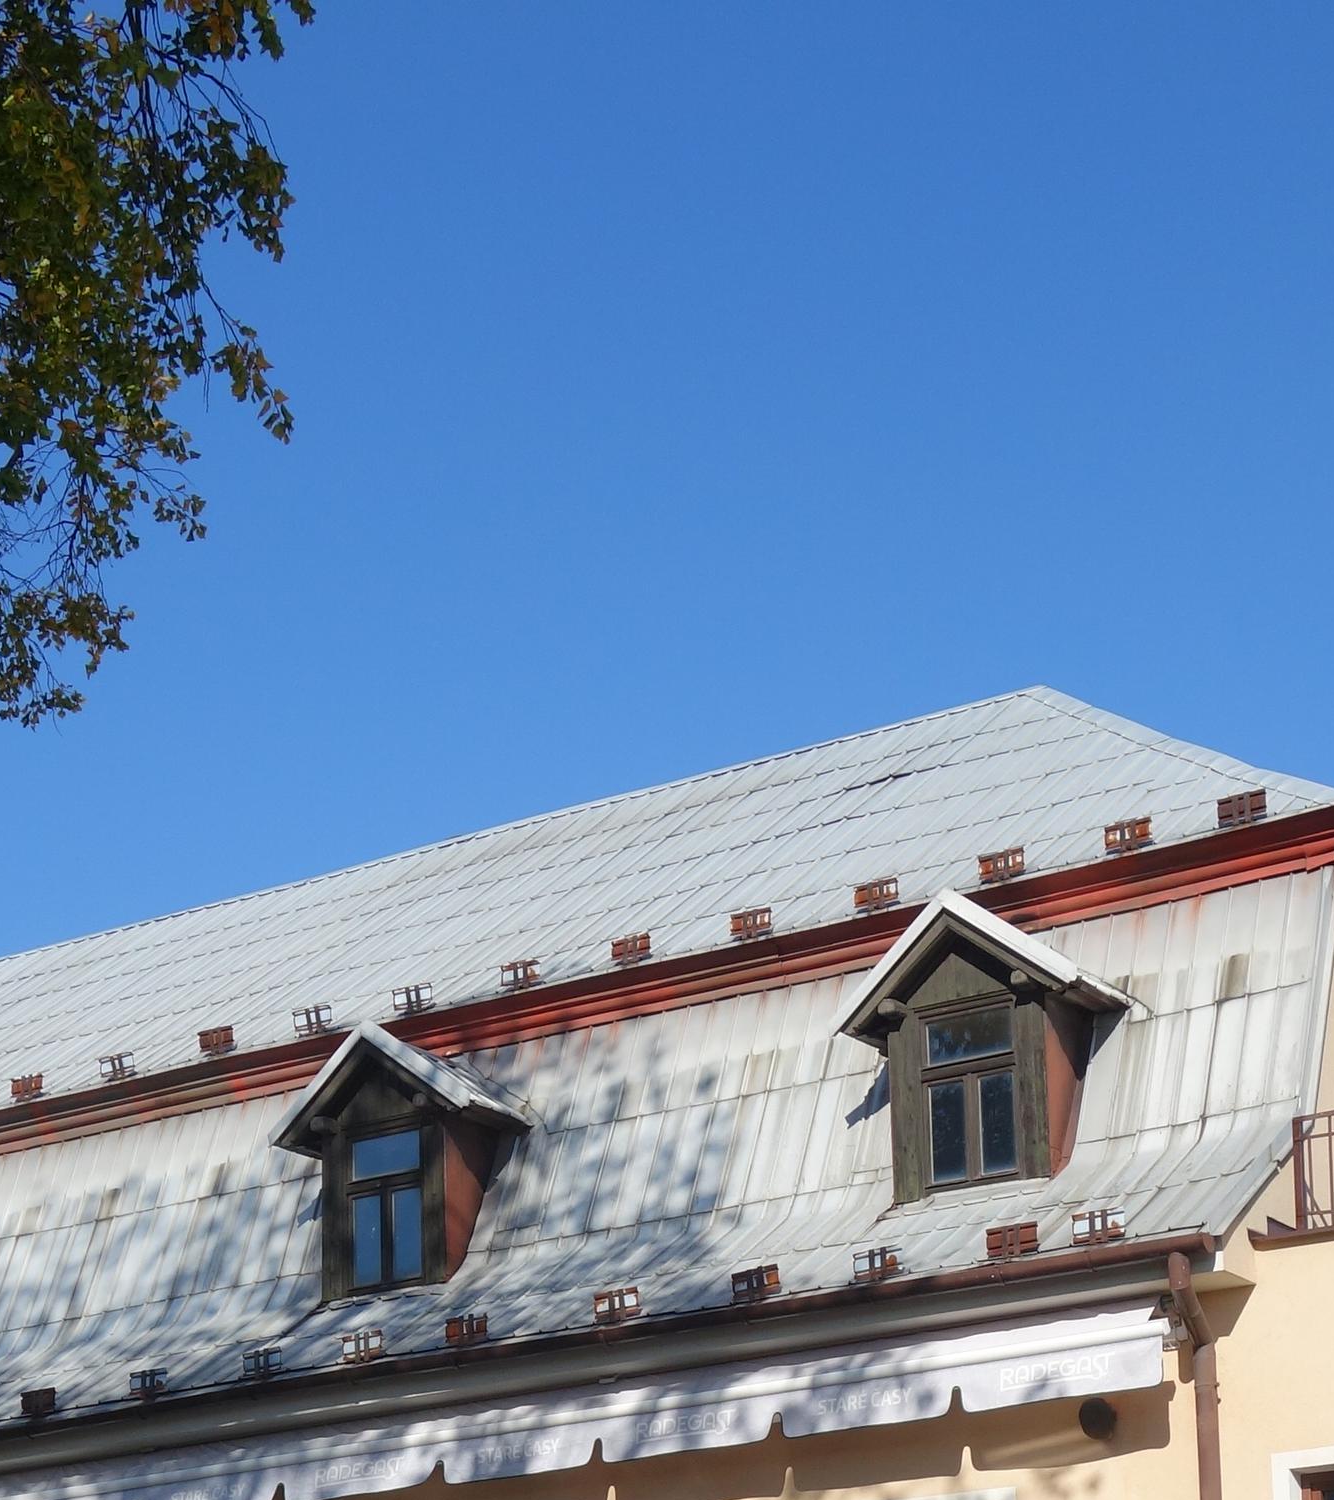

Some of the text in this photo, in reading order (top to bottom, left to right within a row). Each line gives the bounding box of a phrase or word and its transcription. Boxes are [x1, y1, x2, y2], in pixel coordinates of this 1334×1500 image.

[1000, 1351, 1116, 1392] RADEGAST
[635, 1408, 737, 1444] RADEGAST
[315, 1455, 405, 1489] RADEGAST
